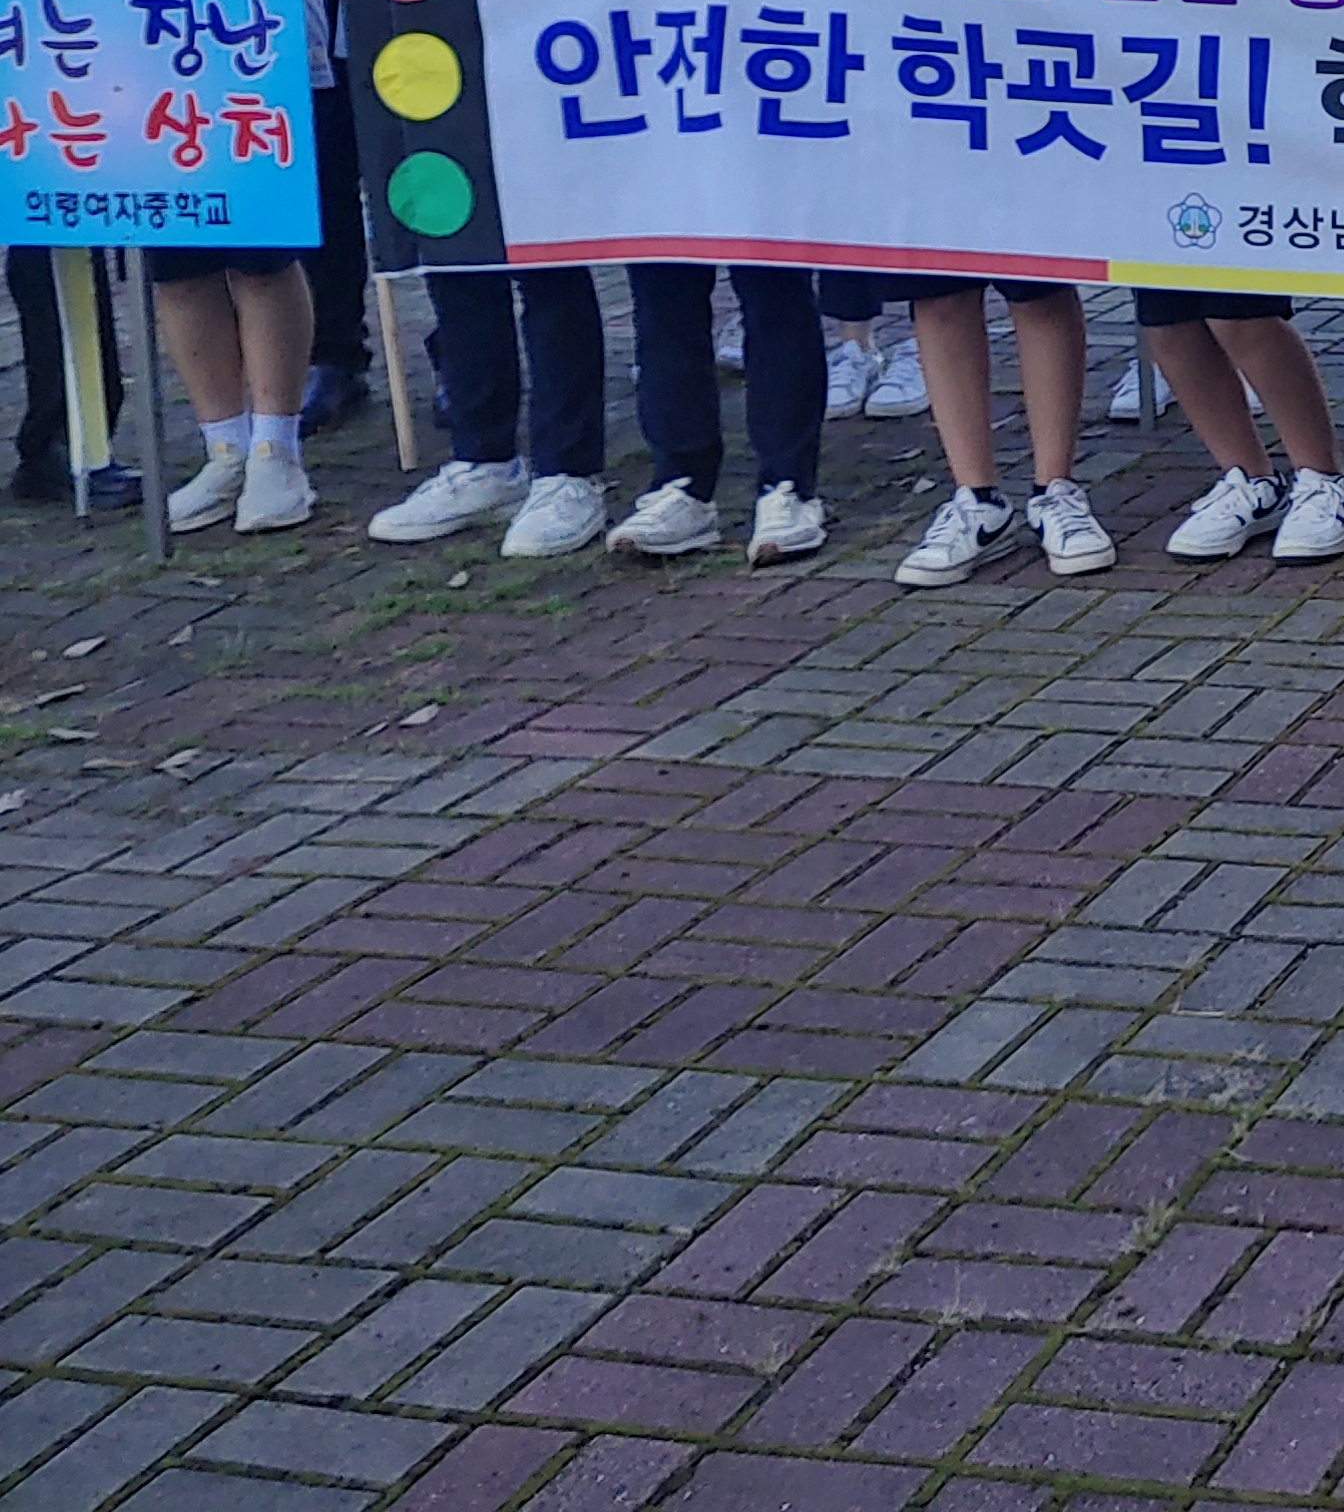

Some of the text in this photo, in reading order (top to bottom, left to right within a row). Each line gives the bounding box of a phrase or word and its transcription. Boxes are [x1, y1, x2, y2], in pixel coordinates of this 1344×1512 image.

[534, 2, 867, 141] 안전한
[890, 13, 1273, 167] 학굣길!
[144, 90, 290, 168] 상처
[26, 191, 231, 229] 의령여자중학교
